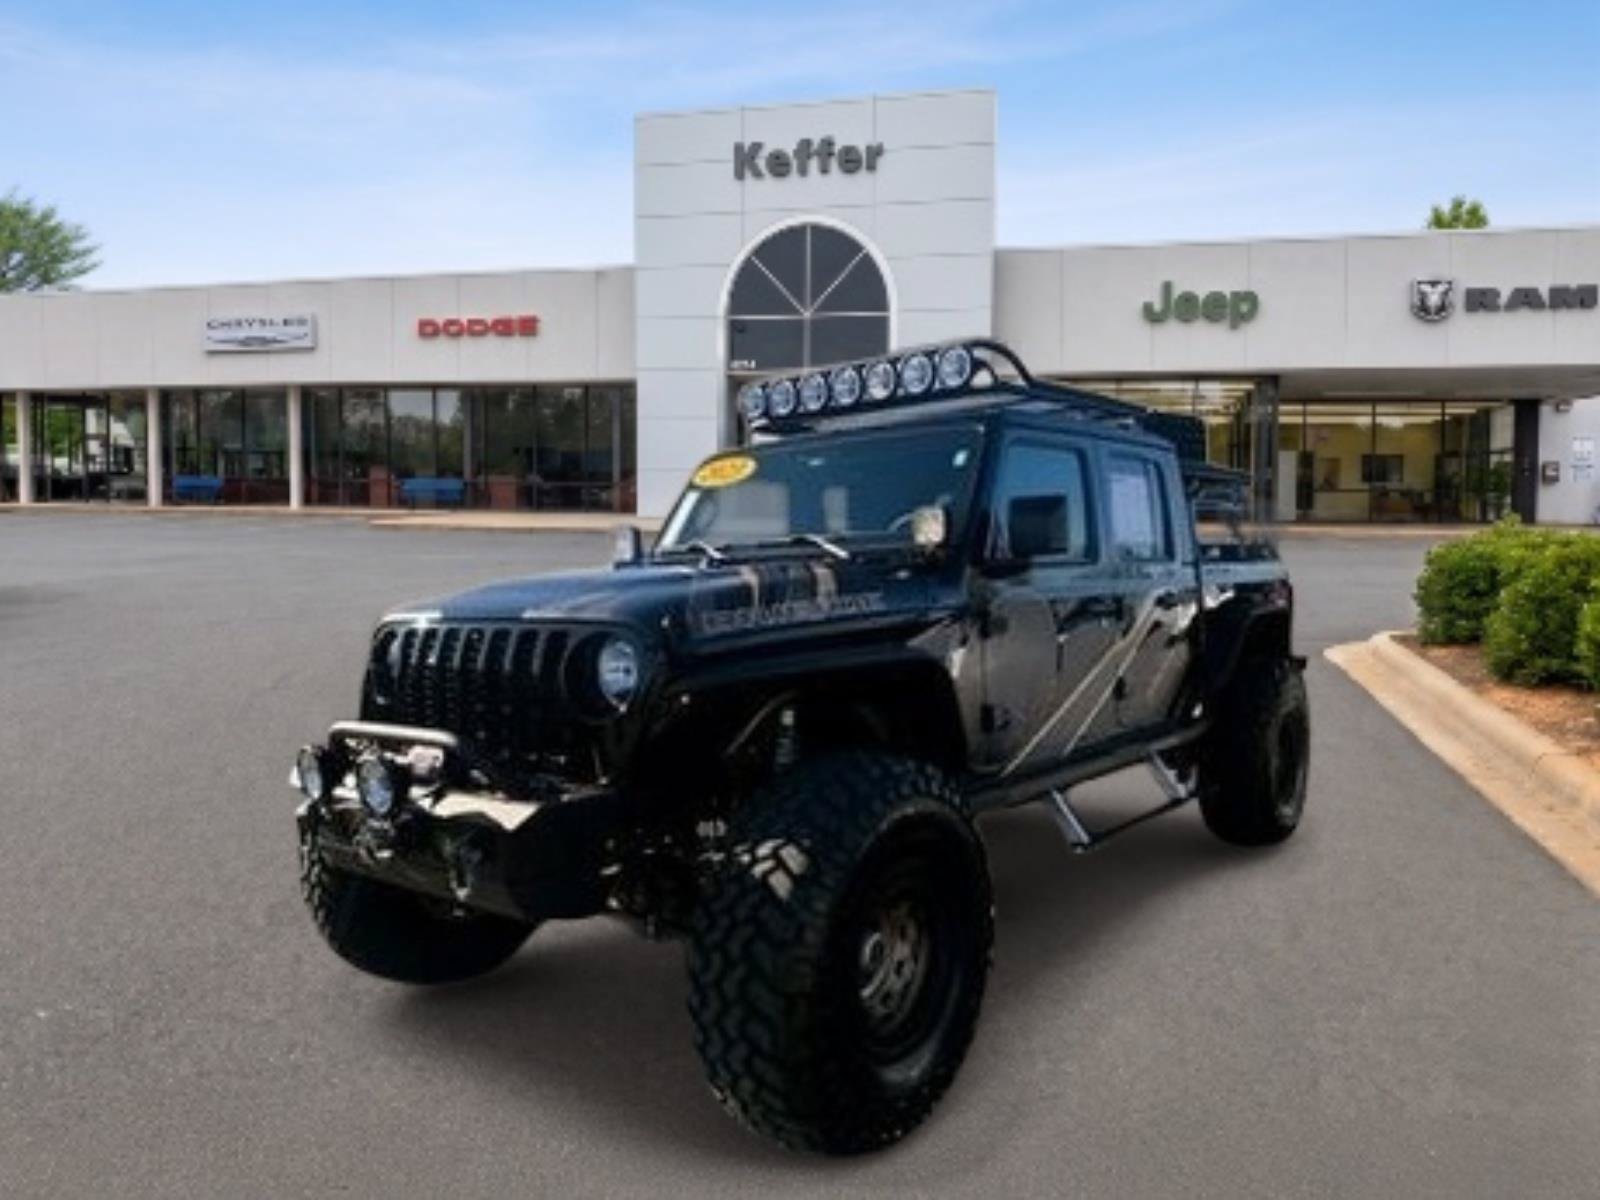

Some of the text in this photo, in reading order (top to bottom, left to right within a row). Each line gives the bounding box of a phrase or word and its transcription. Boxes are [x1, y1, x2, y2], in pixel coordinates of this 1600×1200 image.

[733, 135, 884, 181] Keffer
[1143, 281, 1260, 329] Jeep
[1465, 284, 1599, 313] RAM
[418, 314, 540, 338] DODGE
